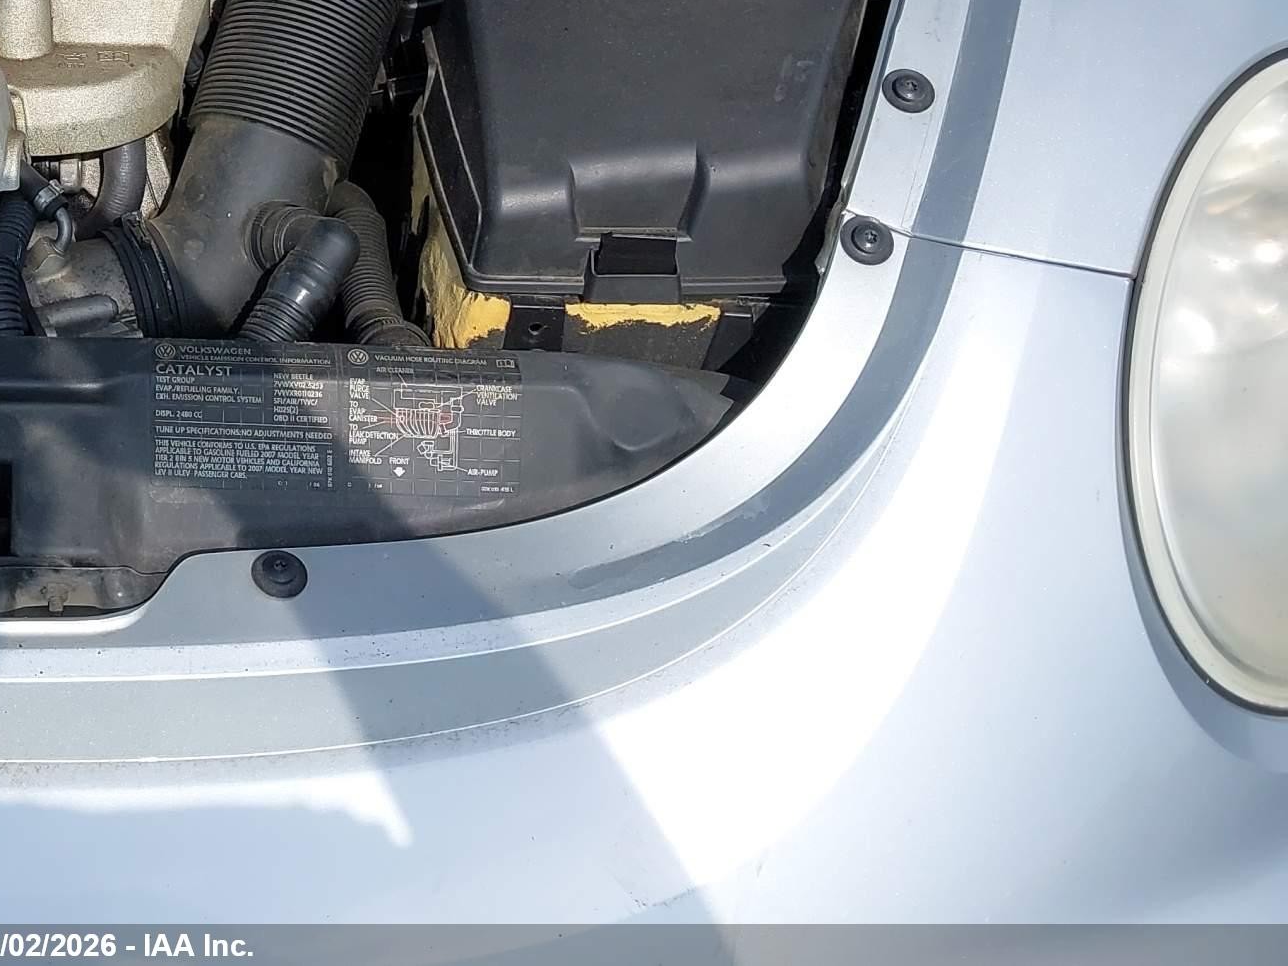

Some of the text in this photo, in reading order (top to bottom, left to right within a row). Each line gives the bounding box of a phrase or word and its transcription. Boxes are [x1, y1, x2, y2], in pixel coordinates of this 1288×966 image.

[179, 345, 251, 355] VOLKSWAGEN
[374, 354, 404, 362] VACUUM
[423, 356, 454, 364] ROUTING
[455, 357, 487, 365] DIAGRAM
[155, 364, 232, 376] CATALYST
[155, 375, 195, 384] TEST GROUP
[349, 384, 370, 392] PURGE
[476, 384, 512, 393] CRANKCASE
[172, 393, 203, 401] EMISSION
[205, 394, 235, 403] CONTROL
[237, 395, 262, 403] SYSTEM
[349, 391, 369, 399] VALVE
[476, 392, 518, 401] VENTILATION
[349, 400, 358, 408] TO
[476, 398, 497, 406] VALVE
[273, 414, 288, 422] OBD
[296, 415, 328, 423] CERTIFIED
[348, 414, 377, 422] CANISTER
[348, 423, 358, 431] TO
[155, 425, 173, 433] TUNE
[175, 426, 185, 434] UP
[254, 429, 303, 439] ADJUSTMENTS
[305, 431, 332, 440] NEEDED
[349, 430, 398, 440] LEAK DETECTION
[466, 428, 516, 437] THROTTLE BODY
[197, 440, 232, 448] CONFORMS
[244, 442, 256, 450] U.S.
[272, 443, 316, 452] REGULATIONS
[155, 446, 192, 454] APPLICABLE
[203, 448, 234, 456] GASOLINE
[236, 449, 259, 458] FUELED
[260, 450, 275, 458] 2007
[277, 451, 300, 459] MODEL
[302, 452, 319, 460] YEAR
[211, 456, 234, 464] MOTOR
[235, 457, 264, 465] VEHICLES
[281, 459, 320, 467] CALIFORNIA
[348, 456, 382, 464] MANIFOLD
[389, 457, 410, 465] FRONT
[155, 461, 198, 469] REGULATIONS
[200, 463, 236, 471] APPLICABLE
[155, 468, 166, 476] LEV
[175, 469, 190, 477] ULEV
[193, 470, 228, 478] PASSENGER
[230, 471, 247, 479] CARS.
[467, 468, 498, 476] AIR-PUMP
